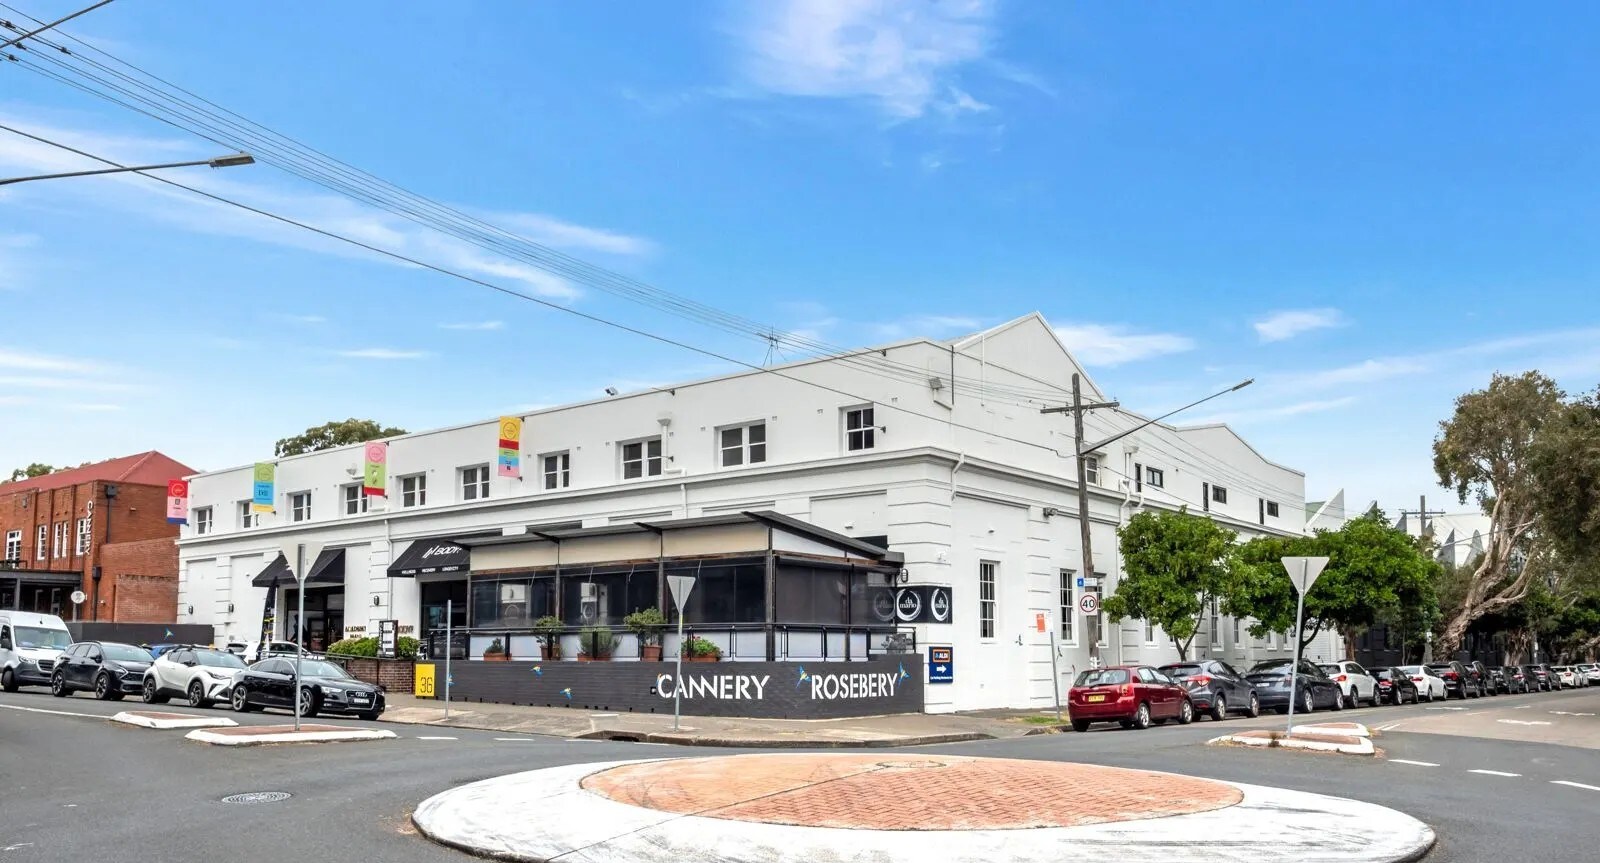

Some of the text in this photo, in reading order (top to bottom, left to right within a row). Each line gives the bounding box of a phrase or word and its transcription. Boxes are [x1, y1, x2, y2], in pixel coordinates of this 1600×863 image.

[85, 500, 94, 556] CANNERY
[1082, 599, 1095, 608] 40
[420, 676, 433, 693] 36
[657, 673, 898, 700] CANNERY ROSEBERY
